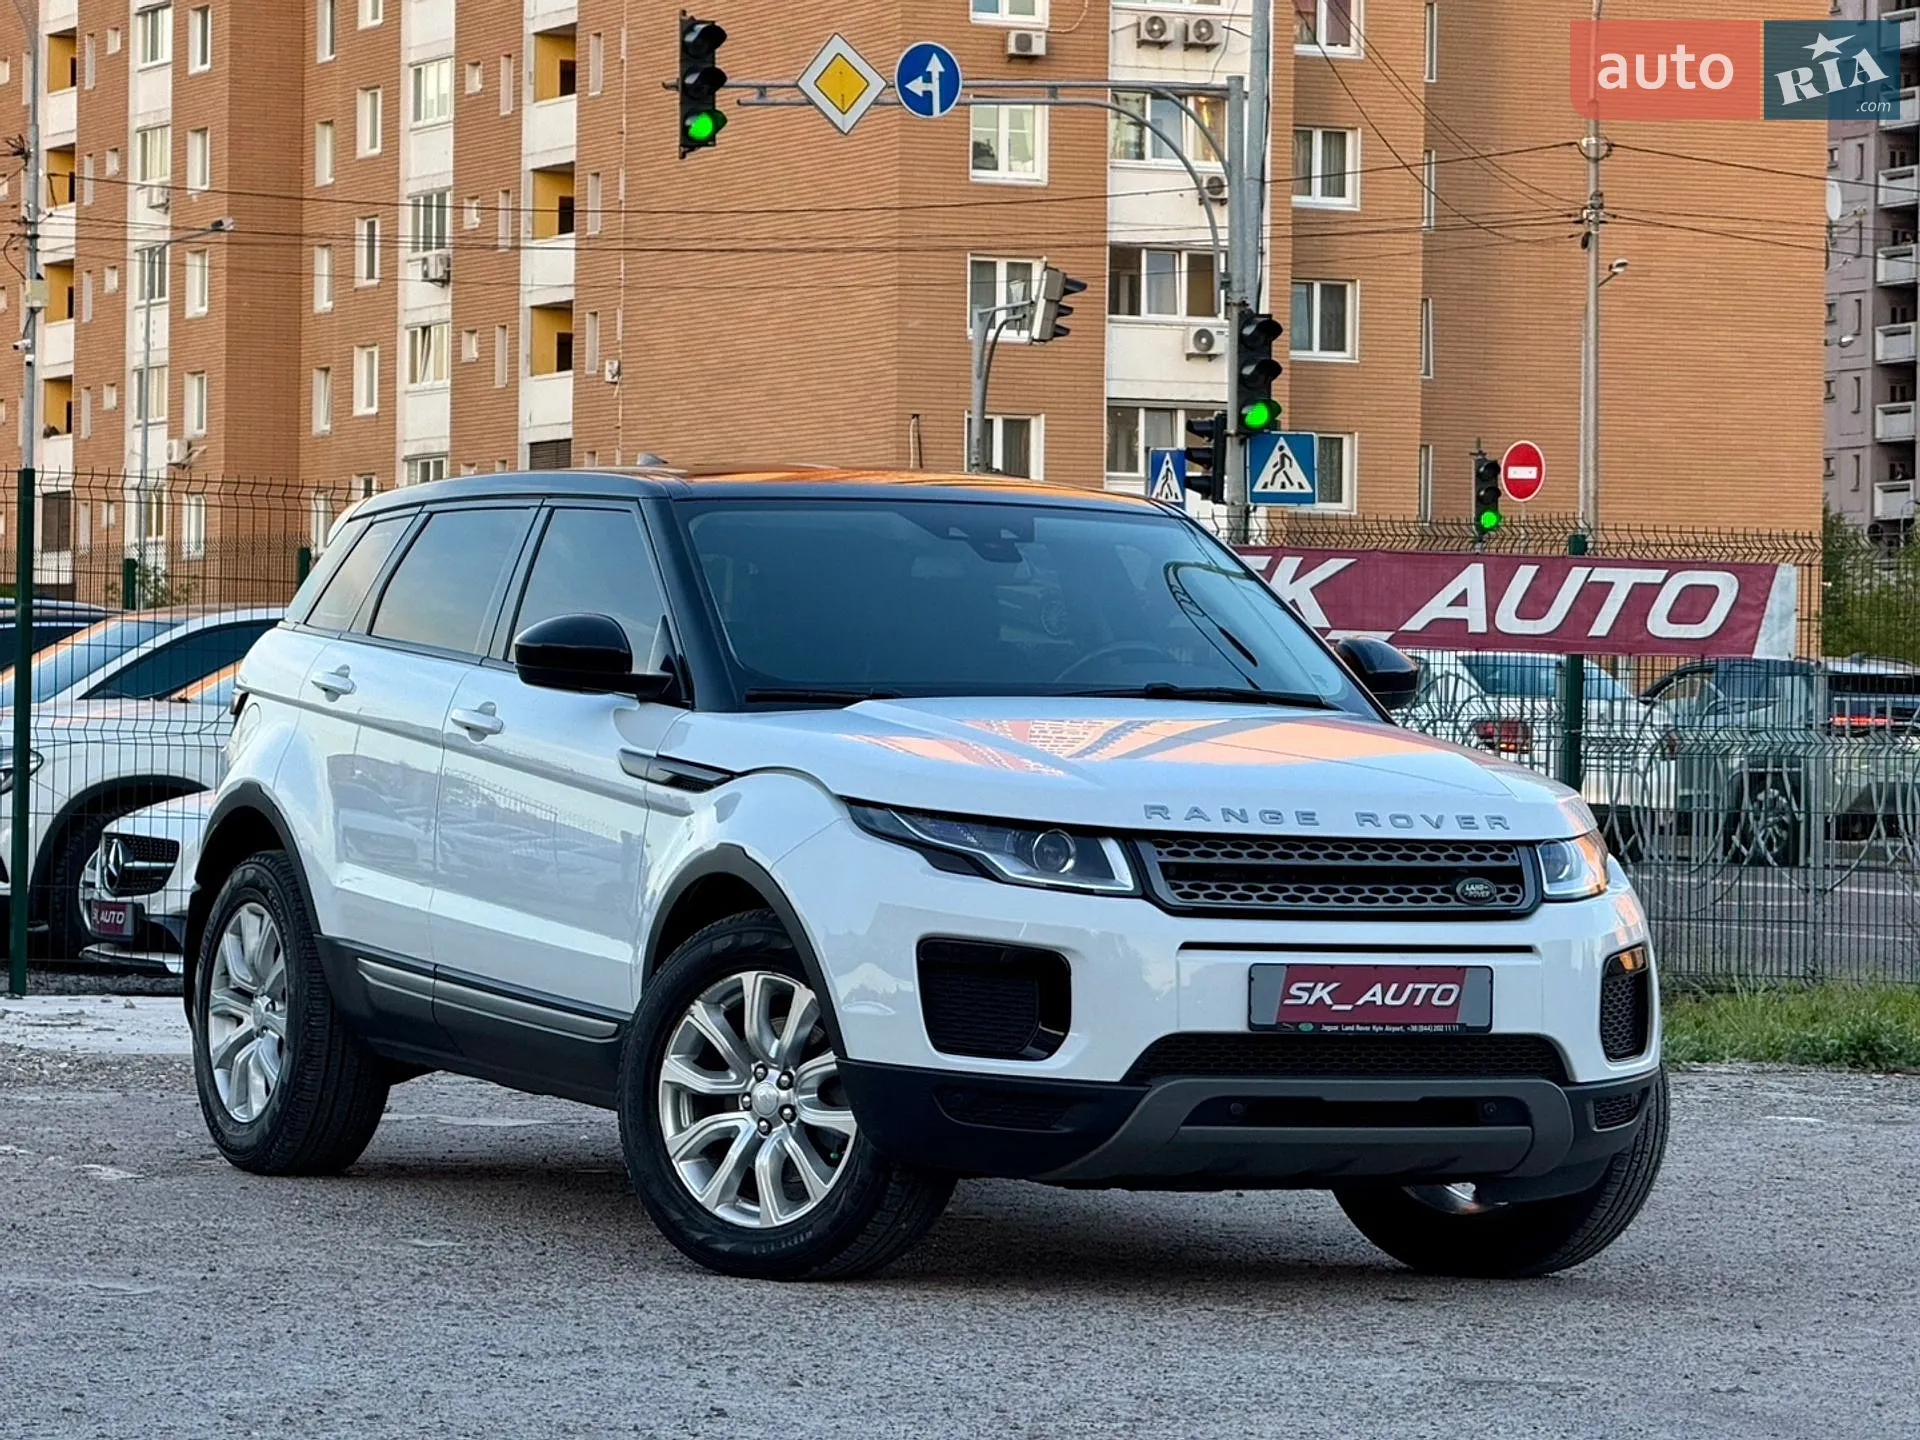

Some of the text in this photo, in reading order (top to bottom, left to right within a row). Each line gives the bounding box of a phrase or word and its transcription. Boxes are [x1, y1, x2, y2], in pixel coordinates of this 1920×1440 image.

[1143, 804, 1511, 831] RANGE ROVER
[1283, 982, 1460, 1011] SK_AUTO
